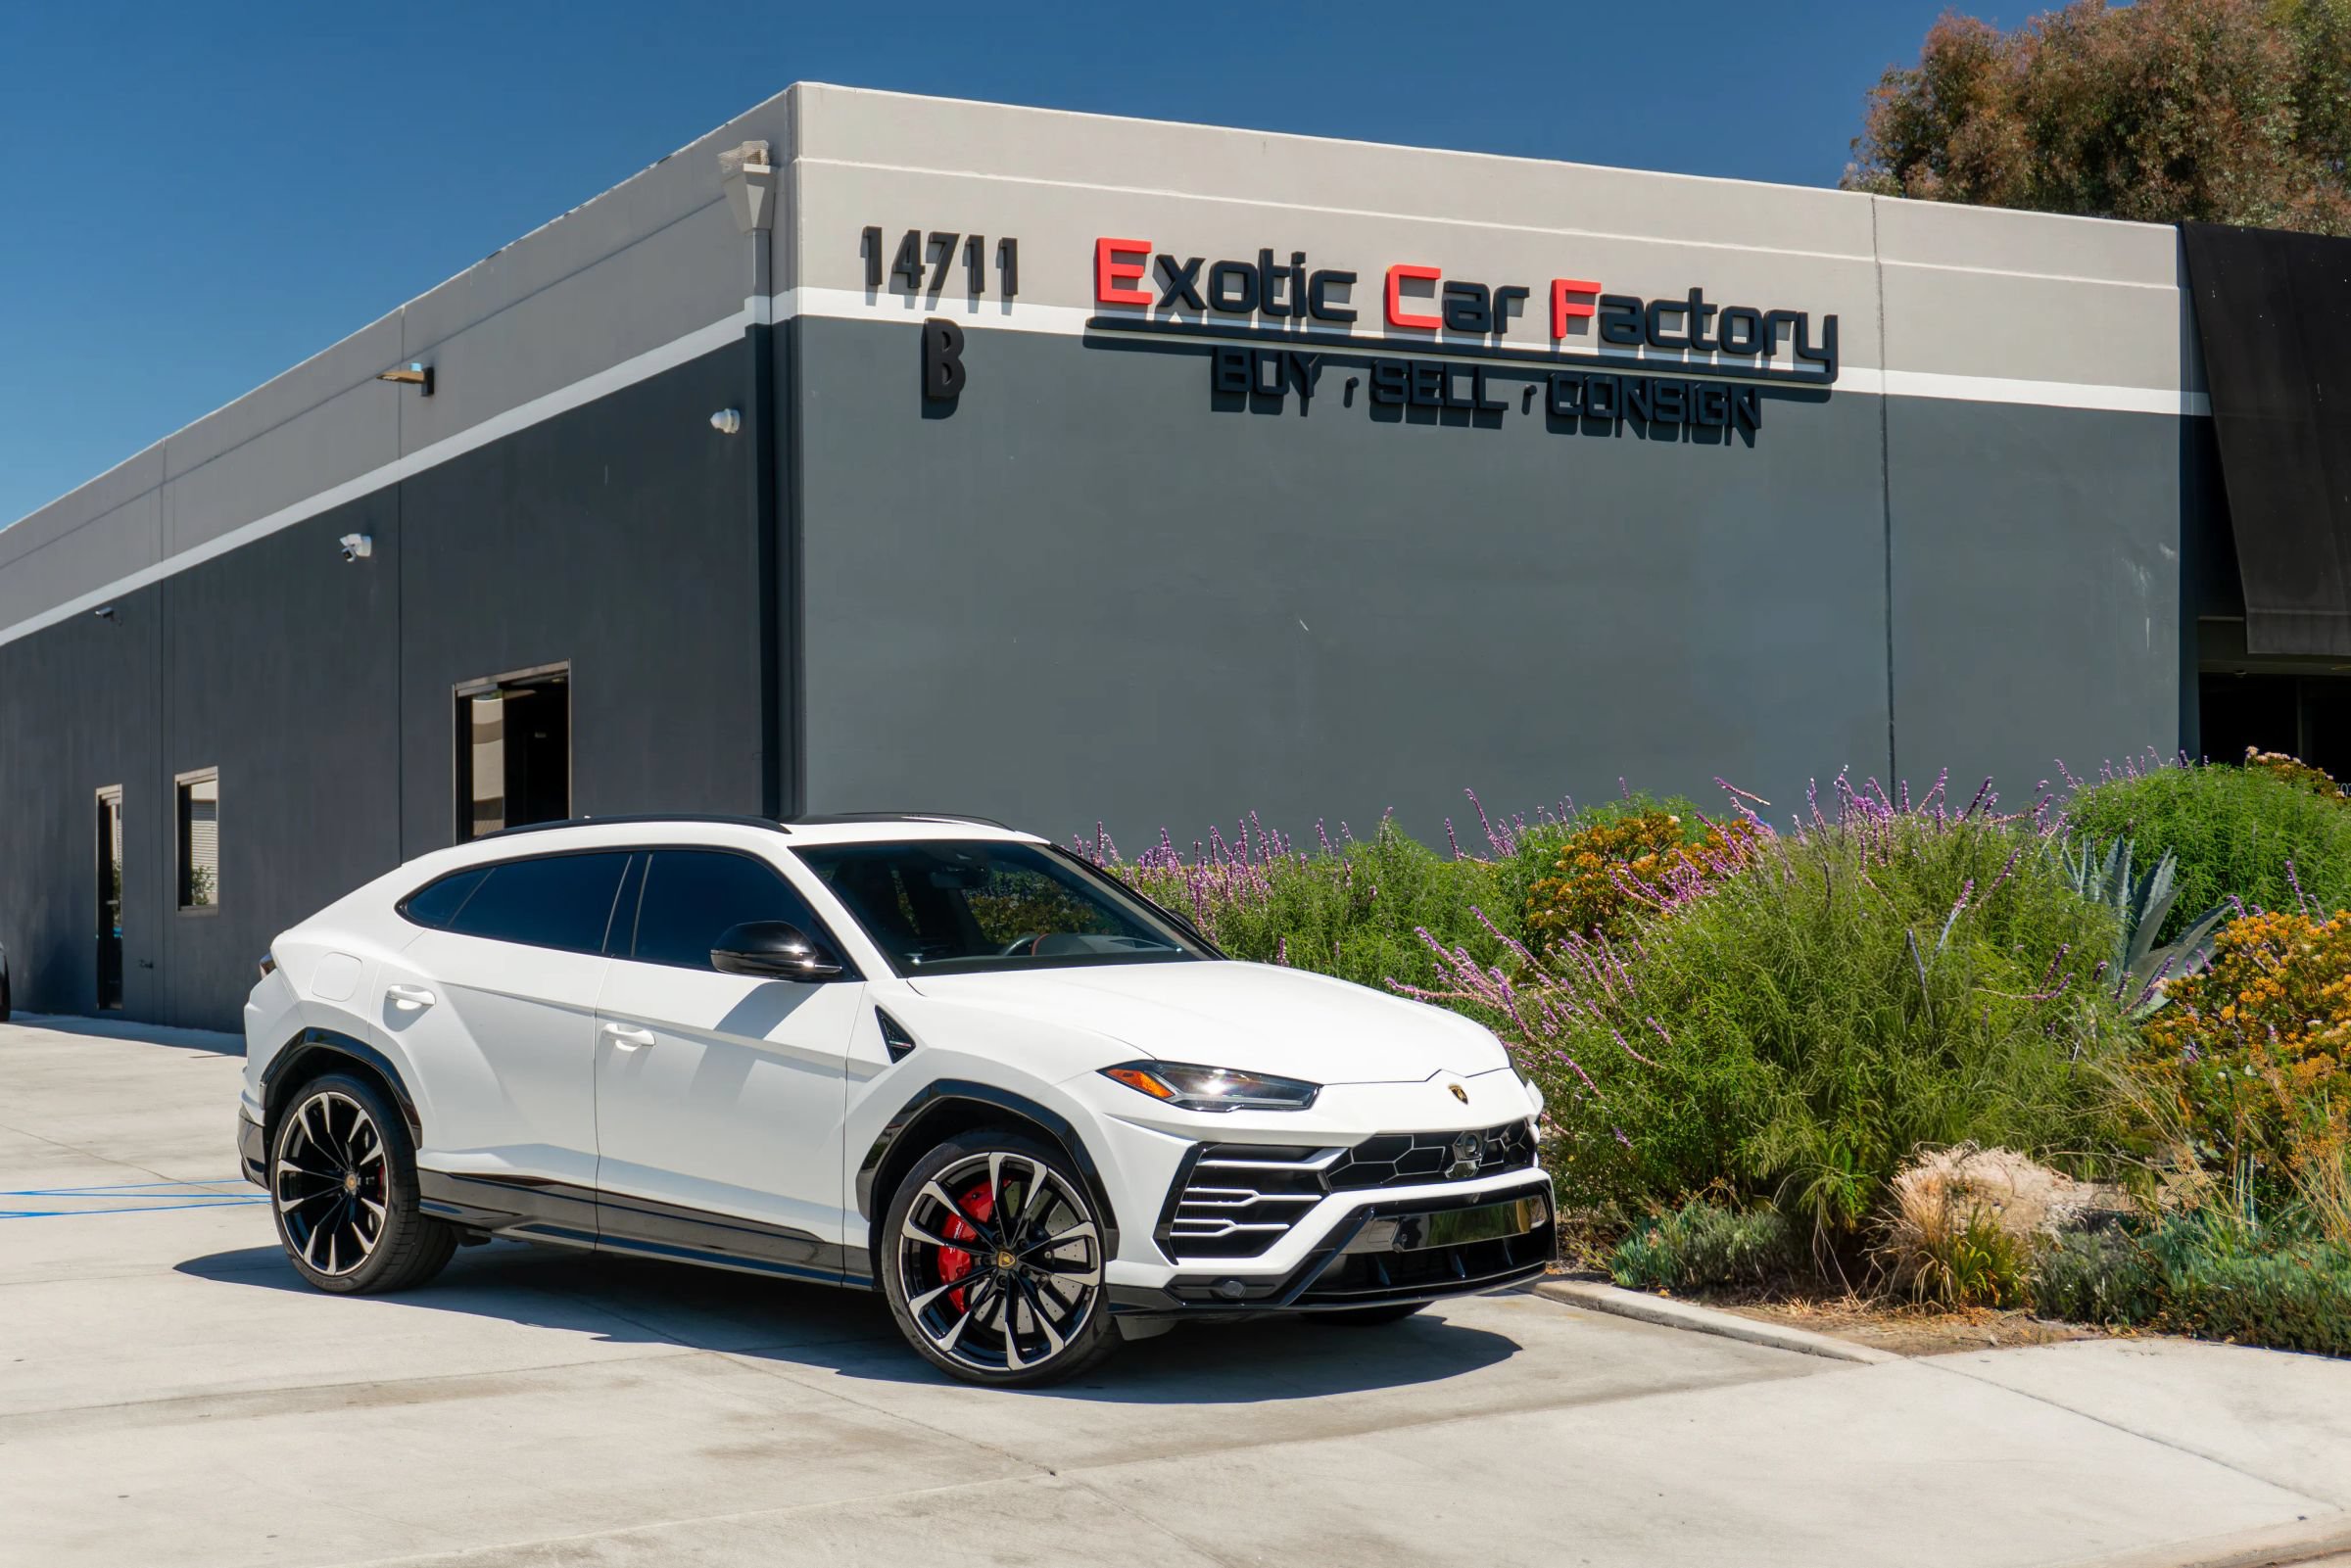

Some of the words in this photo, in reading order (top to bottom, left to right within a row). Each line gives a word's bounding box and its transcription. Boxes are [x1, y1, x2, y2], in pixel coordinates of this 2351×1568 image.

[862, 226, 1018, 296] 14711
[1096, 237, 1357, 322] Exotic
[1386, 264, 1529, 335] Car
[1552, 278, 1839, 383] Factory
[924, 318, 967, 400] B
[1215, 346, 1321, 398] BUY
[1371, 358, 1510, 410] SELL
[1550, 372, 1761, 429] CONSIGN
